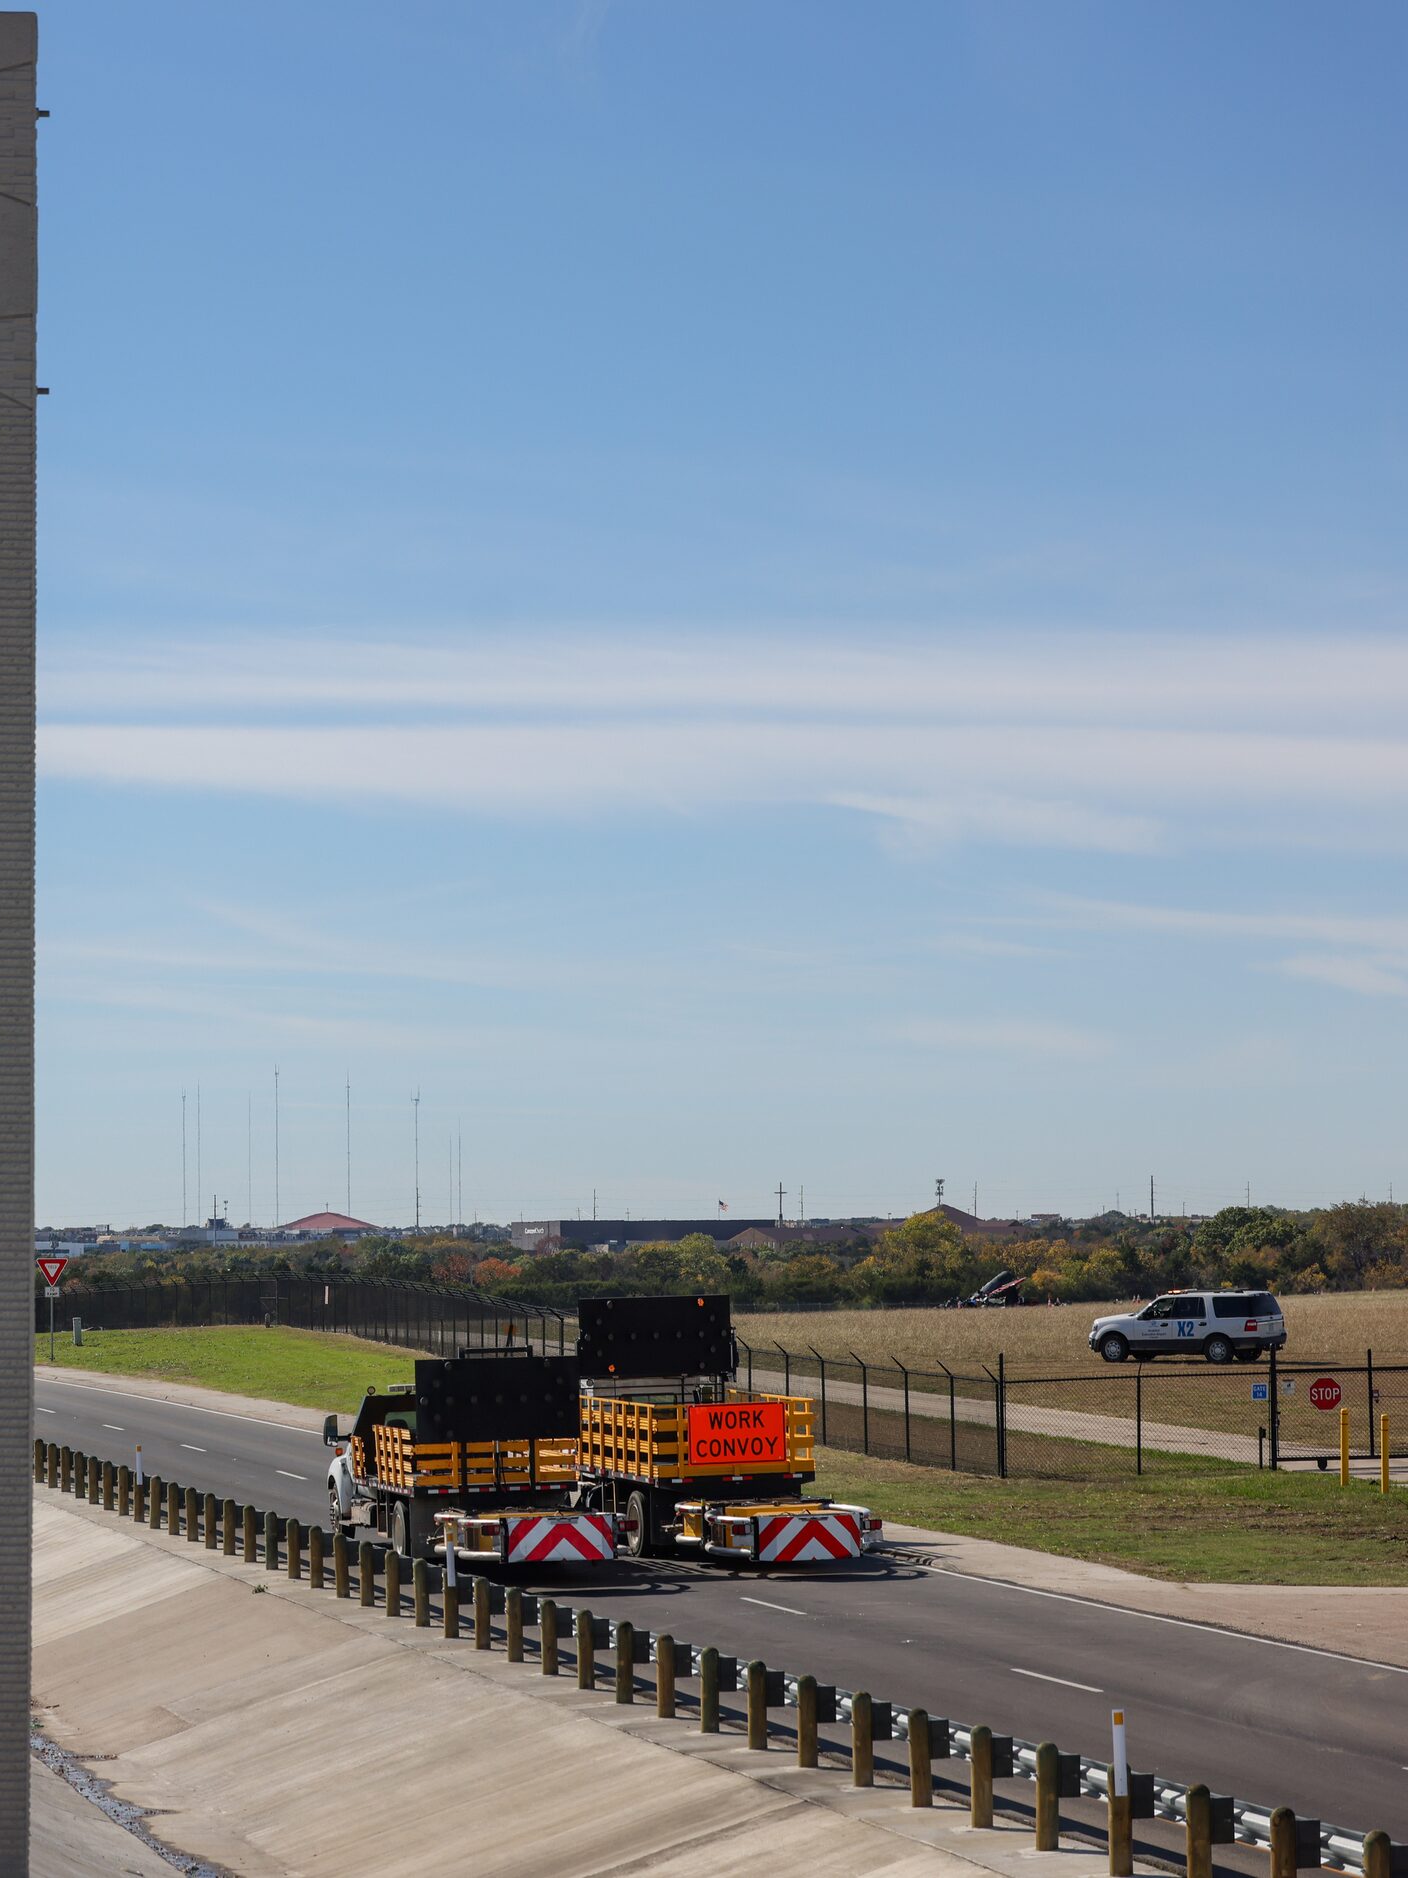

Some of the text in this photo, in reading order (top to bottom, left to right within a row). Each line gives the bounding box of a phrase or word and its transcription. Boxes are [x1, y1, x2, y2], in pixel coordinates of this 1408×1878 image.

[1177, 1320, 1195, 1337] X2
[1311, 1387, 1340, 1401] STOP
[708, 1409, 765, 1430] WORK
[696, 1436, 779, 1458] CONVOY
